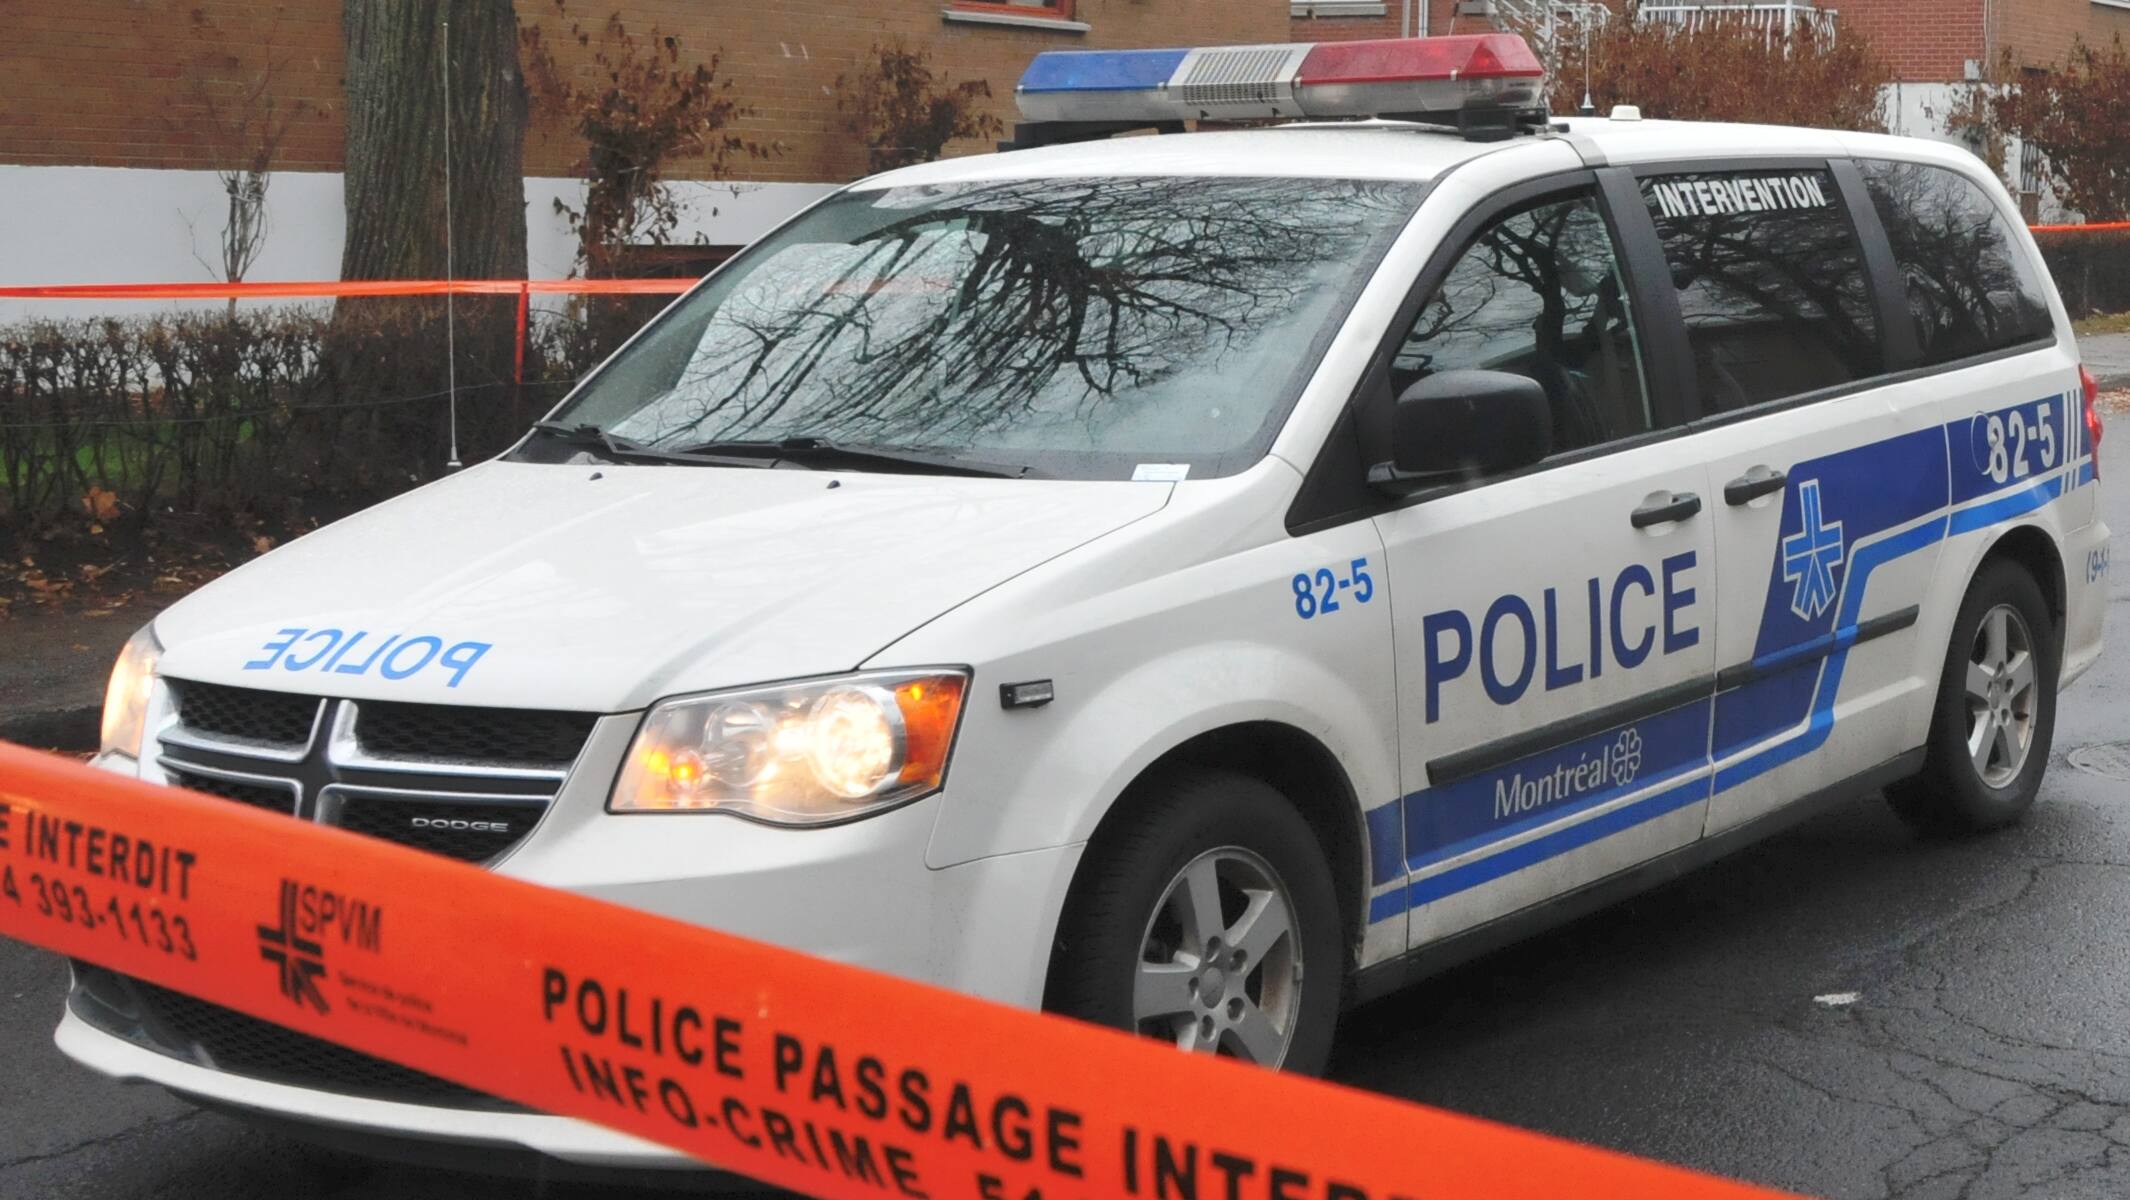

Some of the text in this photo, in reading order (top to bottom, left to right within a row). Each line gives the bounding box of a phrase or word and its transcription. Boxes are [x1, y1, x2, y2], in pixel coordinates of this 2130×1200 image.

[1653, 175, 1826, 218] INTERVENTION
[1986, 401, 2055, 484] 82-5
[1291, 557, 1374, 620] 82-5
[1422, 549, 1700, 725] POLICE
[1494, 743, 1610, 820] Montréal
[25, 808, 196, 900] INTERDIT
[411, 816, 509, 832] DODGE
[30, 872, 198, 962] 393-1133
[302, 885, 382, 954] SPVM
[542, 967, 745, 1079] POLICE
[773, 1032, 1086, 1178] PASSAGE
[560, 1045, 930, 1200] INFO-CRIME
